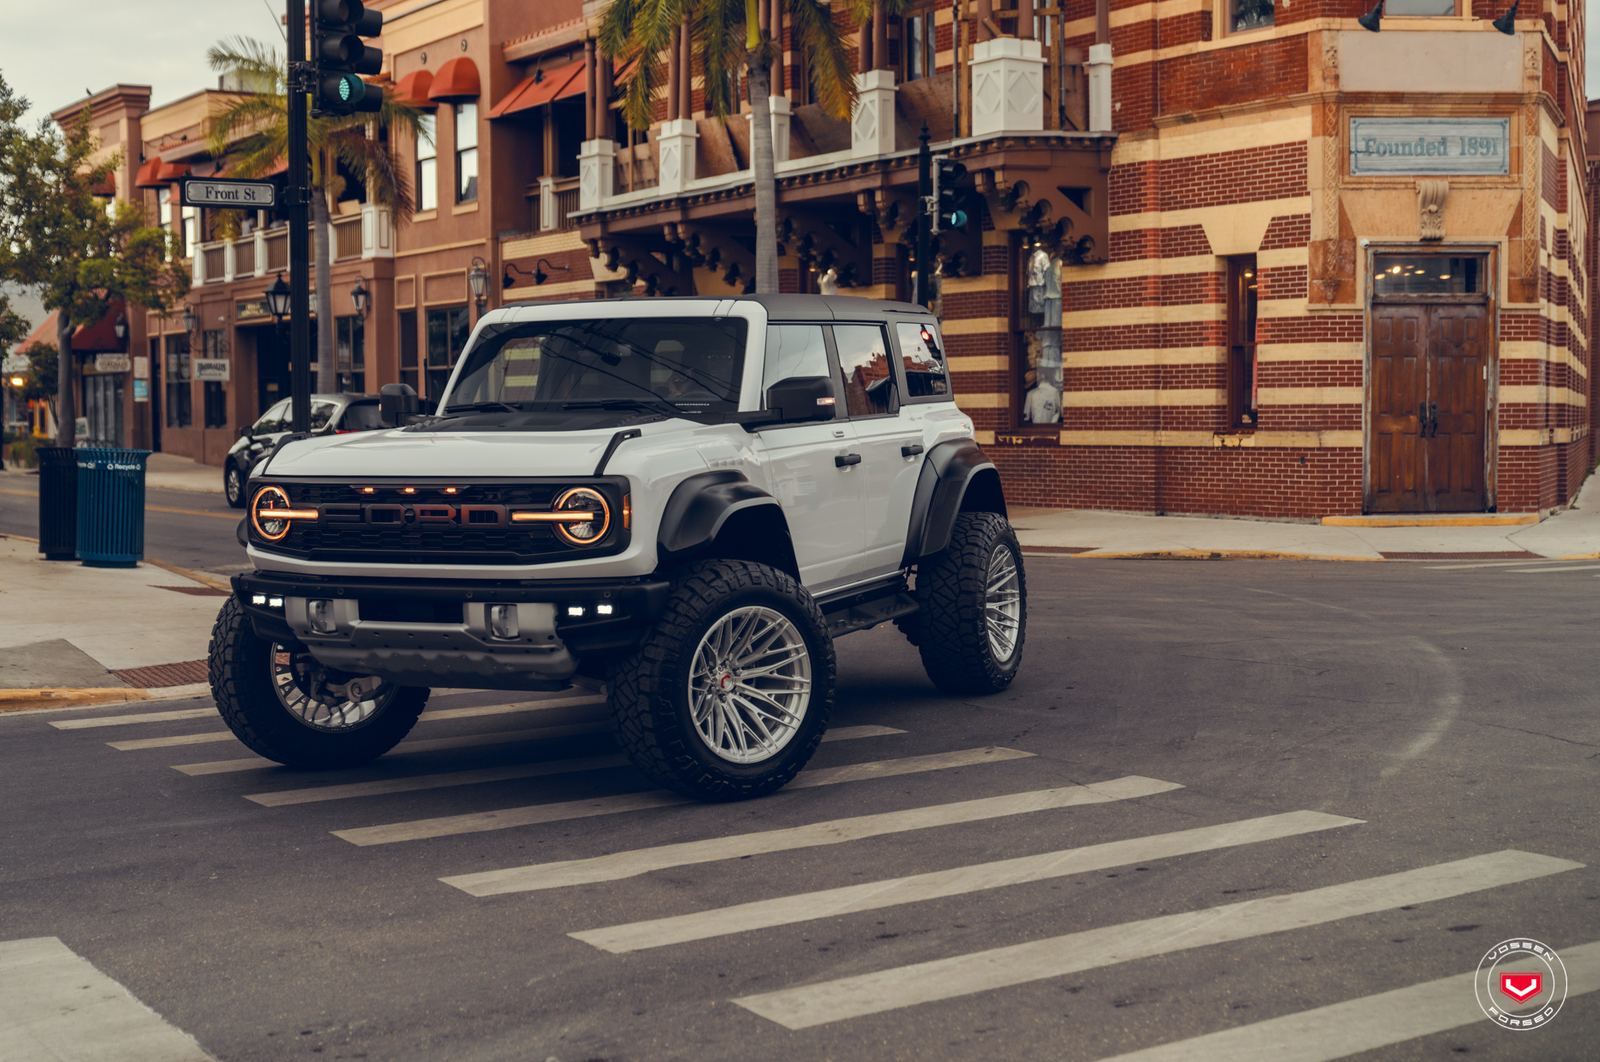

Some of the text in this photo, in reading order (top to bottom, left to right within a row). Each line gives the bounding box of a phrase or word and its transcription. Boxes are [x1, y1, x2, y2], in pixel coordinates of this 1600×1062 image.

[1362, 135, 1500, 157] Founded 1891
[204, 186, 256, 200] Front St
[320, 502, 508, 529] FORD
